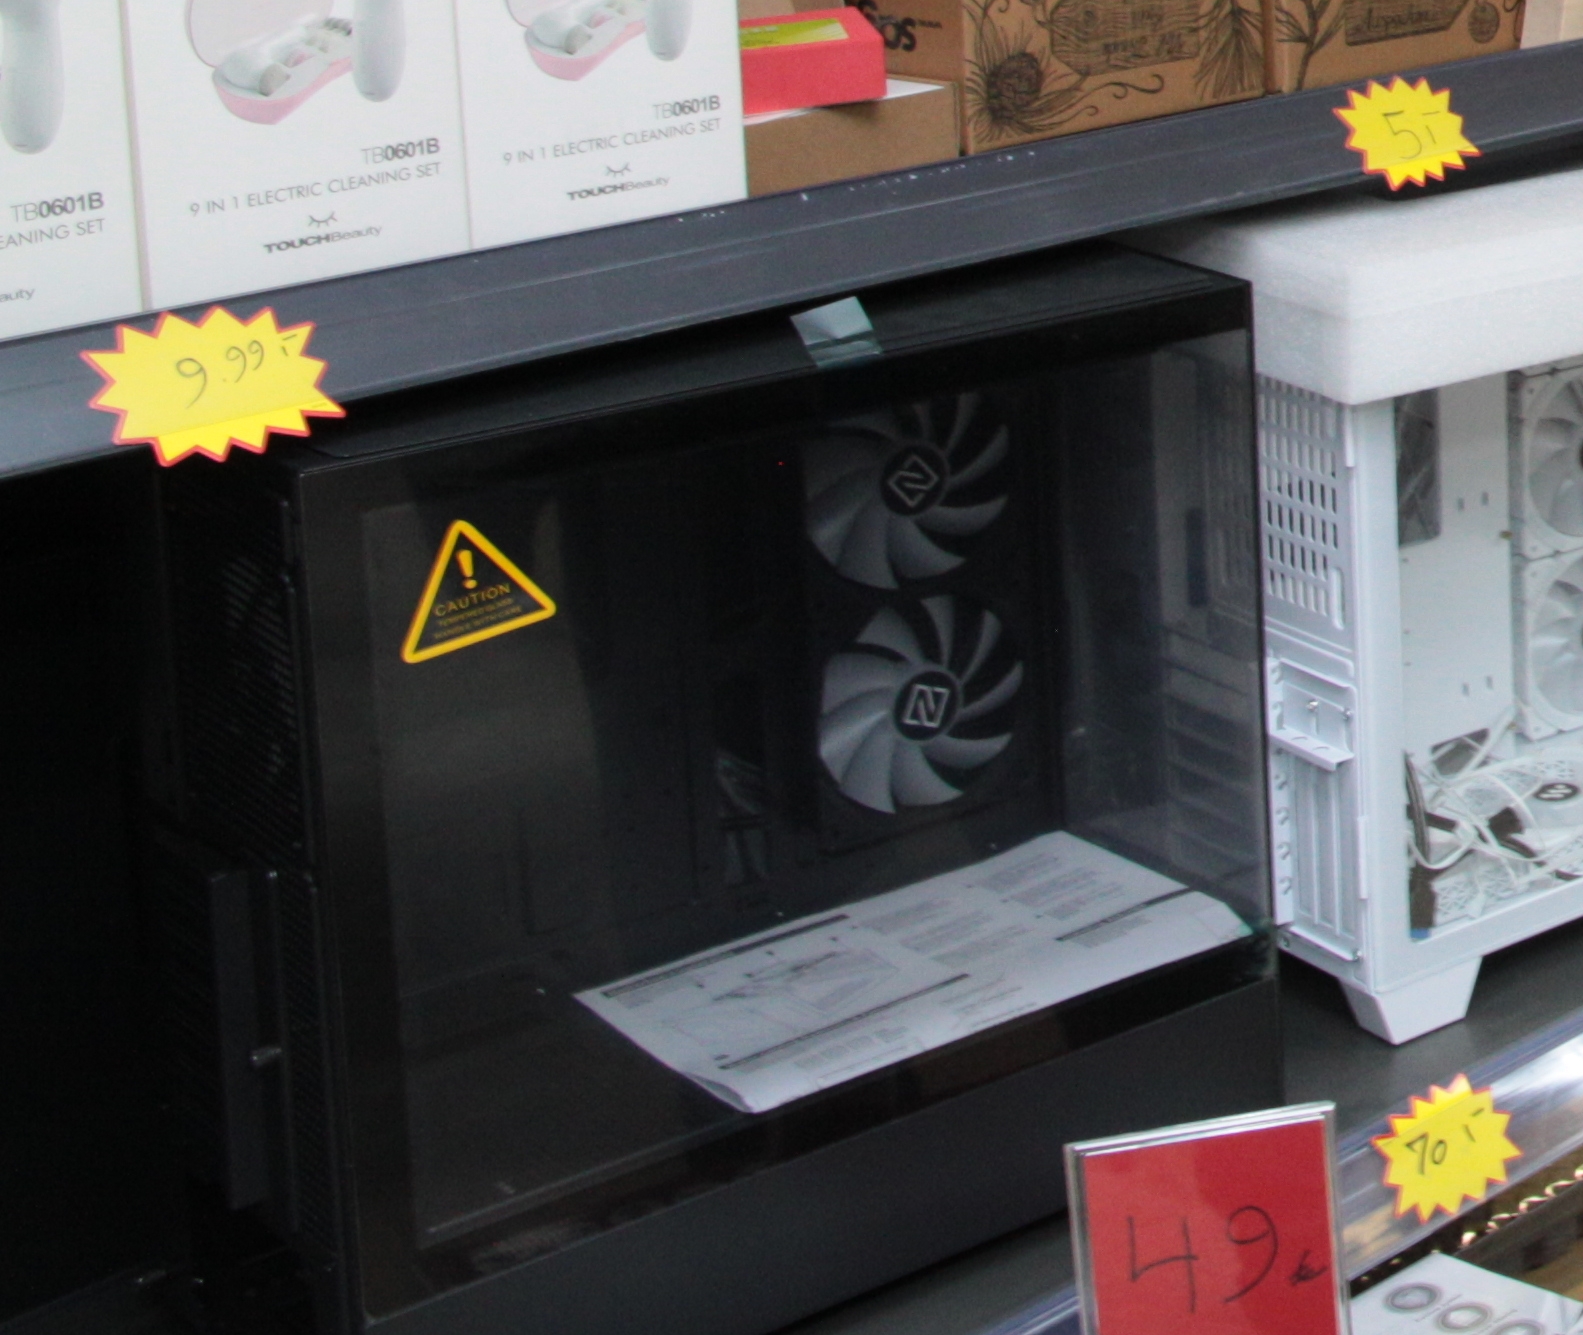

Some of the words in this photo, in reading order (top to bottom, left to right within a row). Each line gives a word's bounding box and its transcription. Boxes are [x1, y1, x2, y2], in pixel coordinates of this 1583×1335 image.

[652, 95, 721, 120] TB0601B
[361, 137, 441, 165] TB0601B
[502, 151, 512, 166] 9
[517, 148, 534, 164] IN
[552, 135, 619, 158] ELECTRIC
[623, 121, 696, 147] CLEANING
[699, 117, 722, 134] SET
[190, 202, 200, 218] 9
[206, 198, 225, 214] IN
[247, 182, 323, 208] ELECTRIC
[327, 167, 412, 194] CLEANING
[415, 161, 441, 178] SET
[567, 176, 670, 201] TOUCHBeauty
[10, 191, 104, 223] TB0601B
[76, 218, 105, 237] SET
[263, 225, 383, 254] TOUCHBeauty
[433, 582, 511, 618] CAUTION
